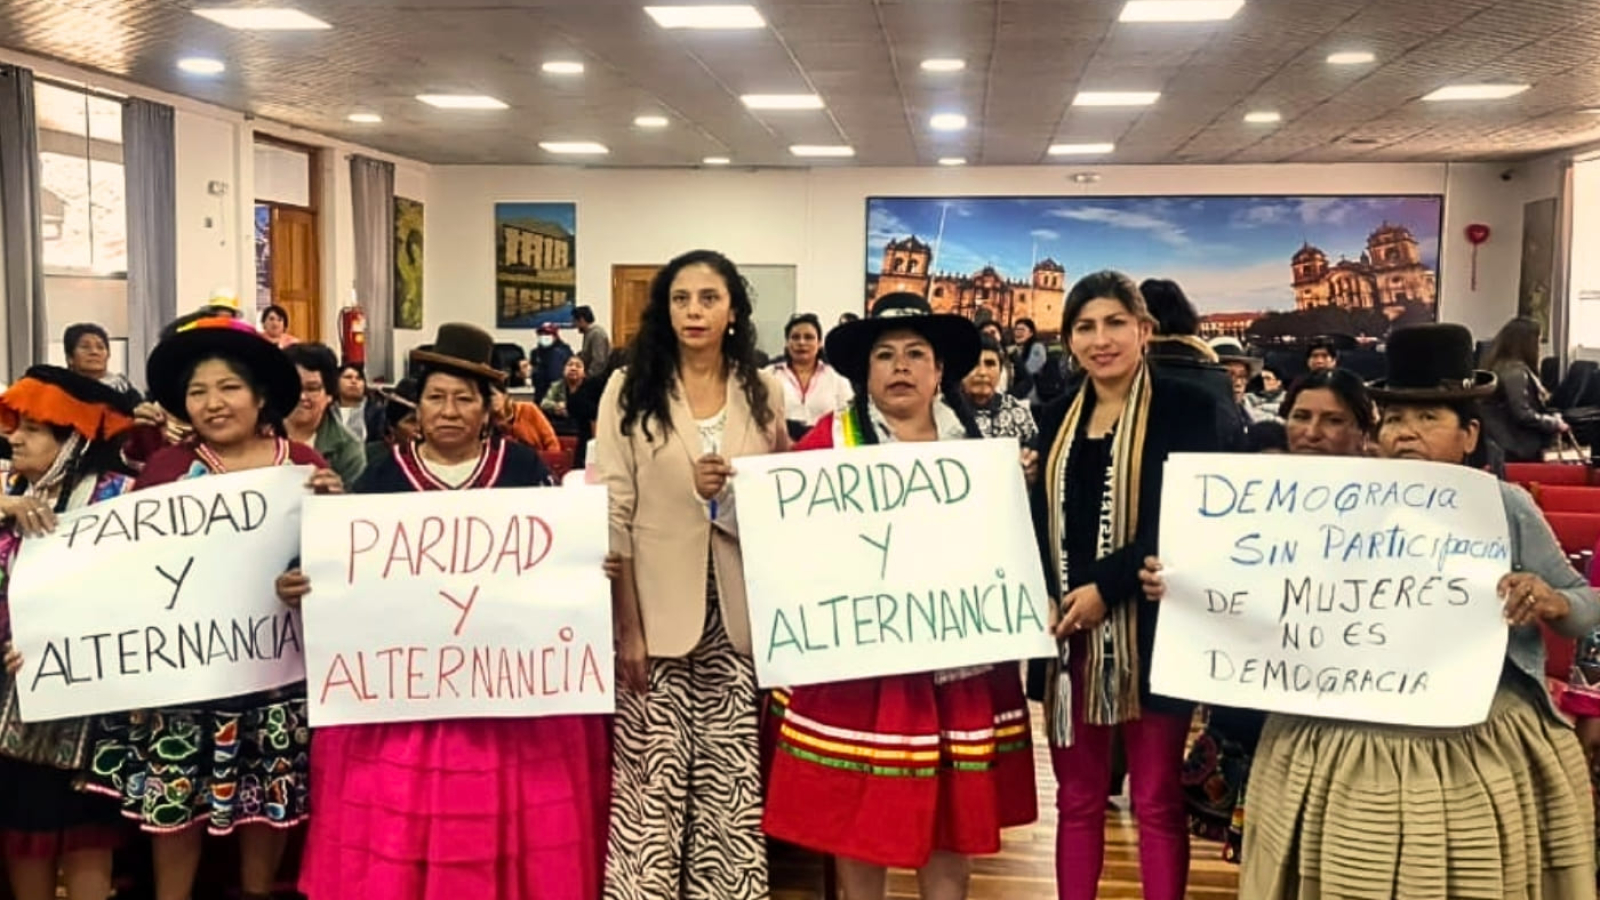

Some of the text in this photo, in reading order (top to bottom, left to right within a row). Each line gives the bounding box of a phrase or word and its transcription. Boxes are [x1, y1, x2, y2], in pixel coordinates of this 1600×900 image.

[767, 457, 972, 519] PARIDAD
[60, 489, 268, 548] PARIDAD
[347, 514, 554, 584] PARIDAD
[859, 522, 892, 580] Y
[155, 556, 194, 610] Y
[439, 584, 480, 636] Y
[1204, 574, 1471, 620] DE MUJERES
[31, 610, 300, 692] ALTERNANCIA
[1281, 621, 1388, 650] NO ES
